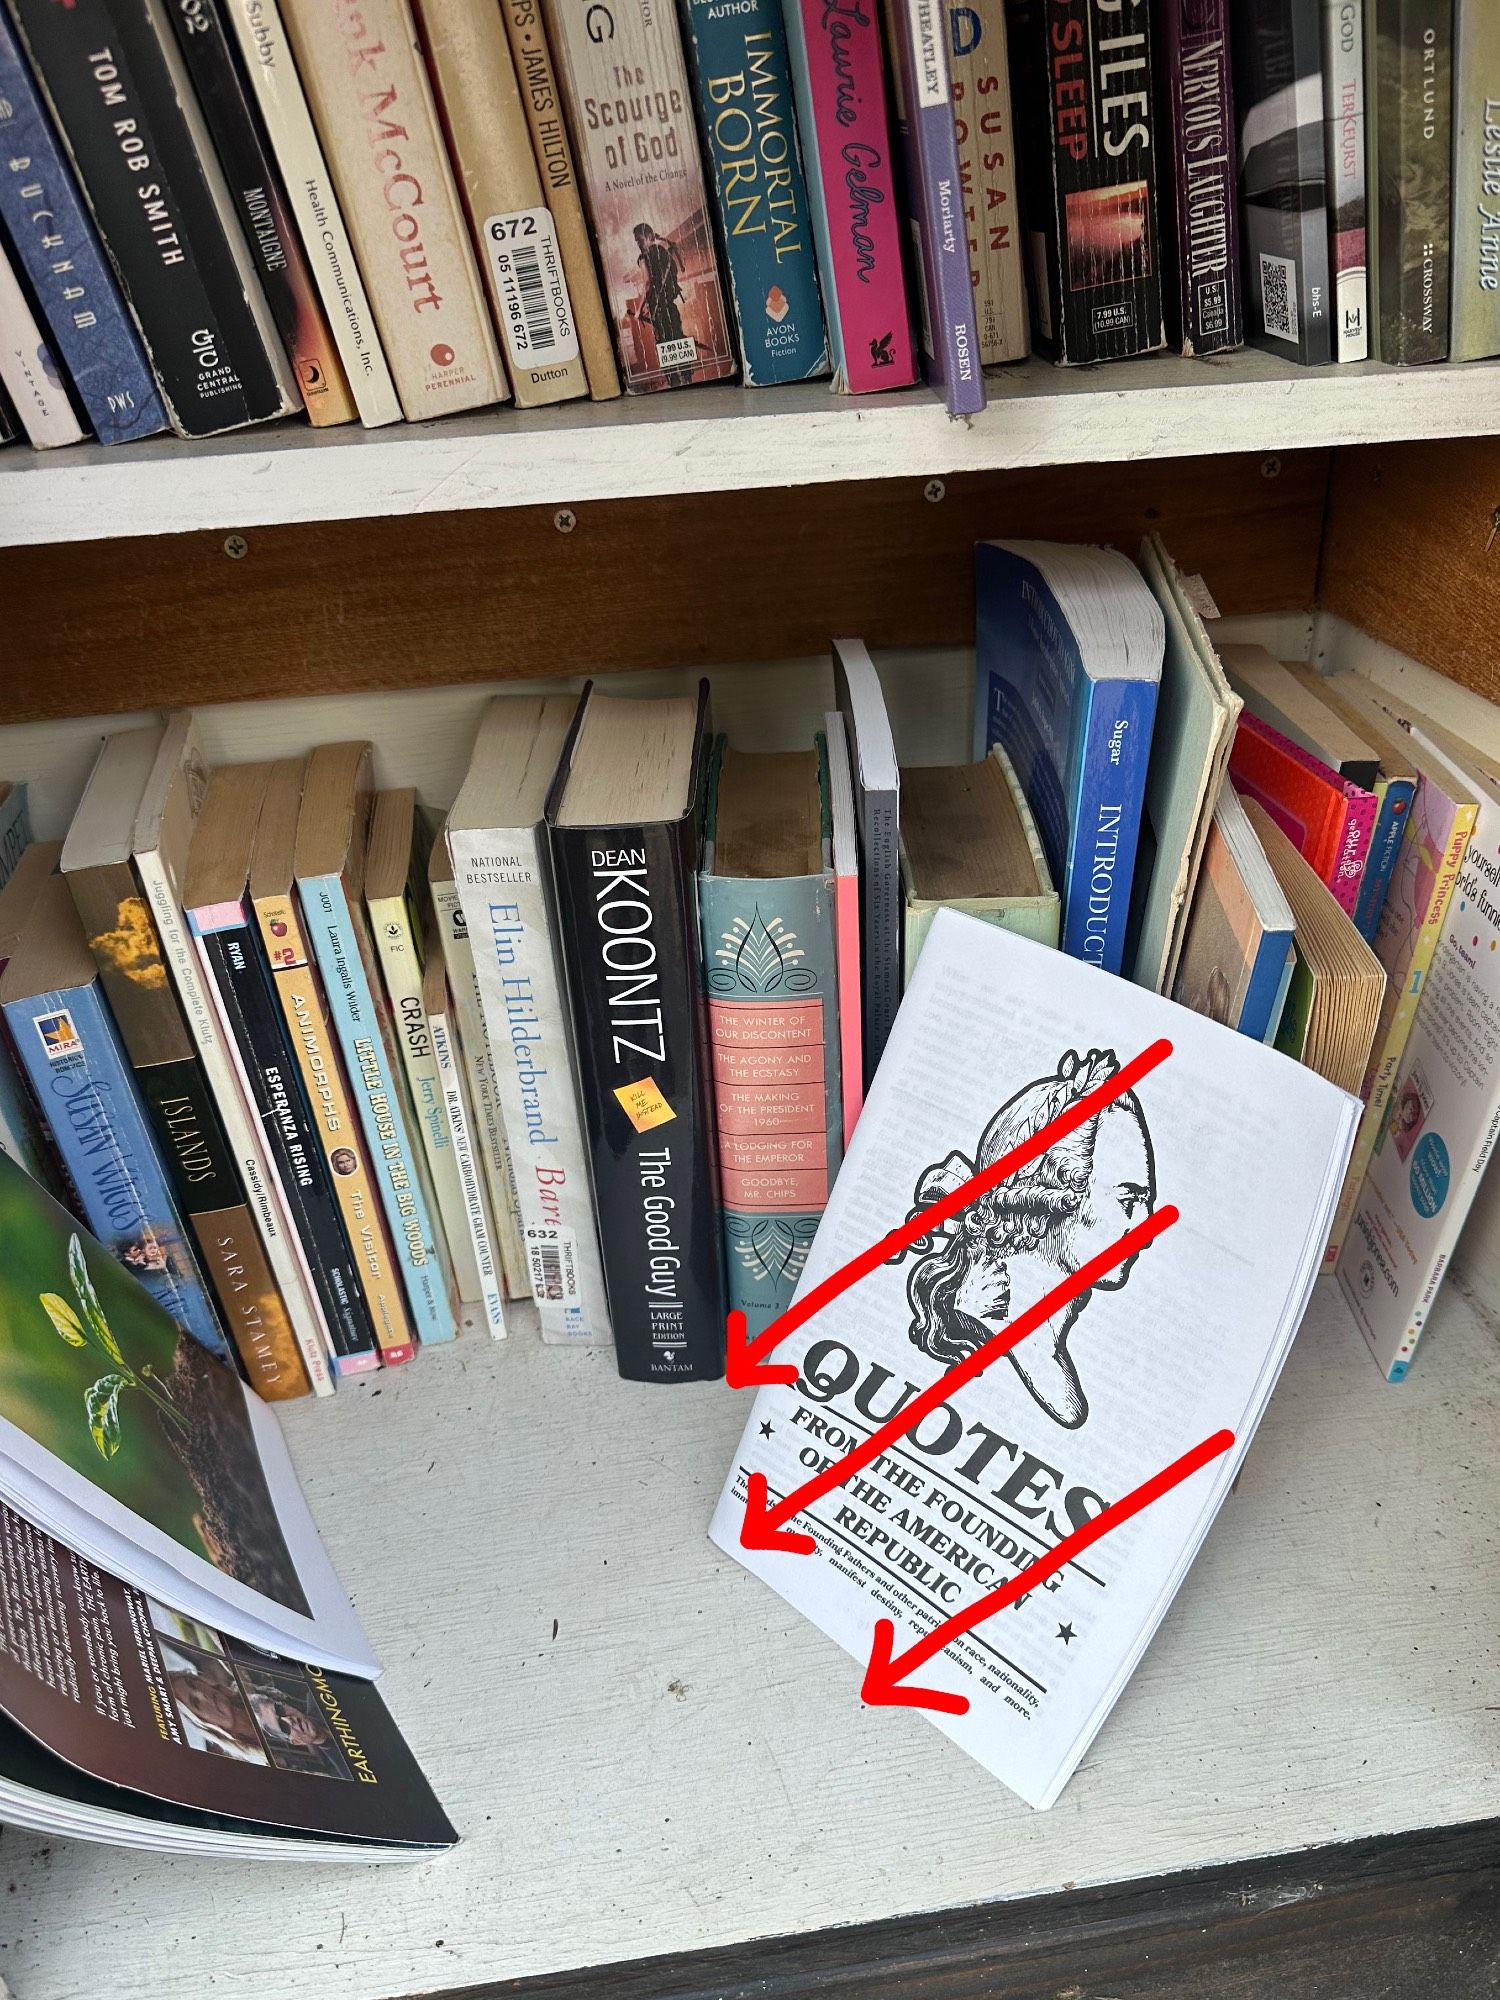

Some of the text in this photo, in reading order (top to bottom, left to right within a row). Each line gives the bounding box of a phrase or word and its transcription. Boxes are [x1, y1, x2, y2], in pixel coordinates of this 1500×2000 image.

[246, 1, 276, 67] Subby
[708, 1, 759, 20] AUTHOR
[613, 65, 645, 89] The
[1053, 18, 1088, 161] SLEEP
[1099, 33, 1151, 157] ILES
[1340, 4, 1358, 179] GOD TERKEURST
[1424, 27, 1436, 140] ORTLUND
[522, 48, 571, 189] JAMES HILTON
[585, 89, 683, 130] Scourge
[88, 47, 186, 267] TOM ROB SMITH
[605, 126, 679, 170] of God
[708, 70, 766, 237] BORN
[744, 30, 802, 265] IMMORTAL
[977, 75, 1011, 251] SUSAN
[1182, 38, 1229, 280] NERVOUS LAUGHTER
[370, 83, 444, 314] McCourt
[612, 168, 688, 190] Novel the Change
[243, 187, 289, 272] MONTAIGNE
[490, 216, 537, 241] 672
[840, 142, 884, 284] Gelman
[935, 180, 957, 254] Moriarty
[305, 178, 375, 377] Health Communications, Inc.
[497, 254, 529, 350] 05 11196 672
[541, 235, 571, 338] THRIFTBOOKS
[1311, 287, 1322, 318] bhs-E
[1423, 258, 1434, 334] CROSSWAY
[765, 332, 800, 348] BOOKS
[766, 322, 795, 337] AVON
[771, 346, 797, 357] Fiction
[955, 323, 972, 382] ROSEN
[14, 350, 49, 417] VINTAGE
[197, 374, 240, 391] CENTRAL
[198, 366, 231, 381] GRAND
[200, 383, 243, 399] PUBLISHING
[425, 374, 477, 392] PERENNIAL
[431, 366, 466, 380] HARPER
[530, 367, 569, 385] Dutton
[107, 393, 135, 413] PWS
[1110, 719, 1128, 766] Sugar
[466, 872, 532, 884] BESTSELLER
[471, 857, 522, 867] NATIONAL
[591, 848, 646, 867] DEAN
[1428, 831, 1468, 925] Puppy Princess
[227, 941, 247, 971] RYAN
[273, 948, 297, 965] #2
[489, 902, 524, 965] Elin
[152, 880, 214, 1046] Juggling for the Complete Klutz
[327, 925, 362, 1023] Laura Ingalls Wilder
[593, 869, 666, 1064] KOONTZ
[1409, 970, 1424, 995] 1
[400, 997, 432, 1058] CRASH
[715, 1028, 812, 1040] OUR DISCONTENT
[719, 1015, 806, 1026] THE WINTER OF
[48, 1040, 80, 1054] MIRA
[291, 994, 341, 1132] ANIMORPHS
[433, 1024, 452, 1069] ATKINS
[502, 976, 559, 1145] Hilderbrand
[718, 1053, 812, 1065] THE AGONY AND
[1378, 1057, 1397, 1082] Party
[730, 1069, 800, 1078] THE ECSTASY
[732, 1093, 800, 1102] THE MAKING
[265, 1066, 313, 1187] ESPERANZA RISING
[416, 1076, 449, 1149] Jerry Spinelli
[720, 1103, 815, 1114] OF THE PRESIDENT
[753, 1117, 780, 1126] 1960
[160, 1096, 216, 1183] ISLANDS
[354, 1037, 429, 1268] LITTLE HOUSE IN THE BIG WOODS
[733, 1153, 804, 1163] THE EMPEROR
[734, 1140, 813, 1151] LODGING FOR
[245, 1159, 277, 1238] Cassidy/Rimbeaux
[350, 1190, 365, 1220] The
[741, 1177, 798, 1187] GOODBYE,
[744, 1190, 797, 1199] MR. CHIPS
[460, 1153, 494, 1276] CARBOHYDRATE COUNTER
[527, 1229, 558, 1239] 632
[638, 1147, 680, 1297] The Good Guy
[563, 1242, 576, 1295] THRIFTBOOKS
[217, 1236, 281, 1385] SARA STAMEY
[488, 1294, 501, 1325] EVANS
[651, 1312, 683, 1320] LARGE
[652, 1322, 683, 1330] PRINT
[741, 1300, 772, 1310] Volume
[651, 1364, 693, 1372] BANTAM
[786, 1339, 1111, 1541] QUOTES
[870, 1454, 926, 1498] THE
[833, 1504, 962, 1604] REPUBLIC
[73, 1569, 97, 1673] somebody know
[802, 1522, 1040, 1708] Founding Fathers and other race, nationality,
[829, 1557, 1031, 1721] manifest destiny, and more.
[98, 1646, 119, 1722] form chronic
[123, 1587, 170, 1741] FEATURING MARIEL HEMINGWAY,
[134, 1594, 183, 1745] AMY SMART DEEPAK CHOPRA,
